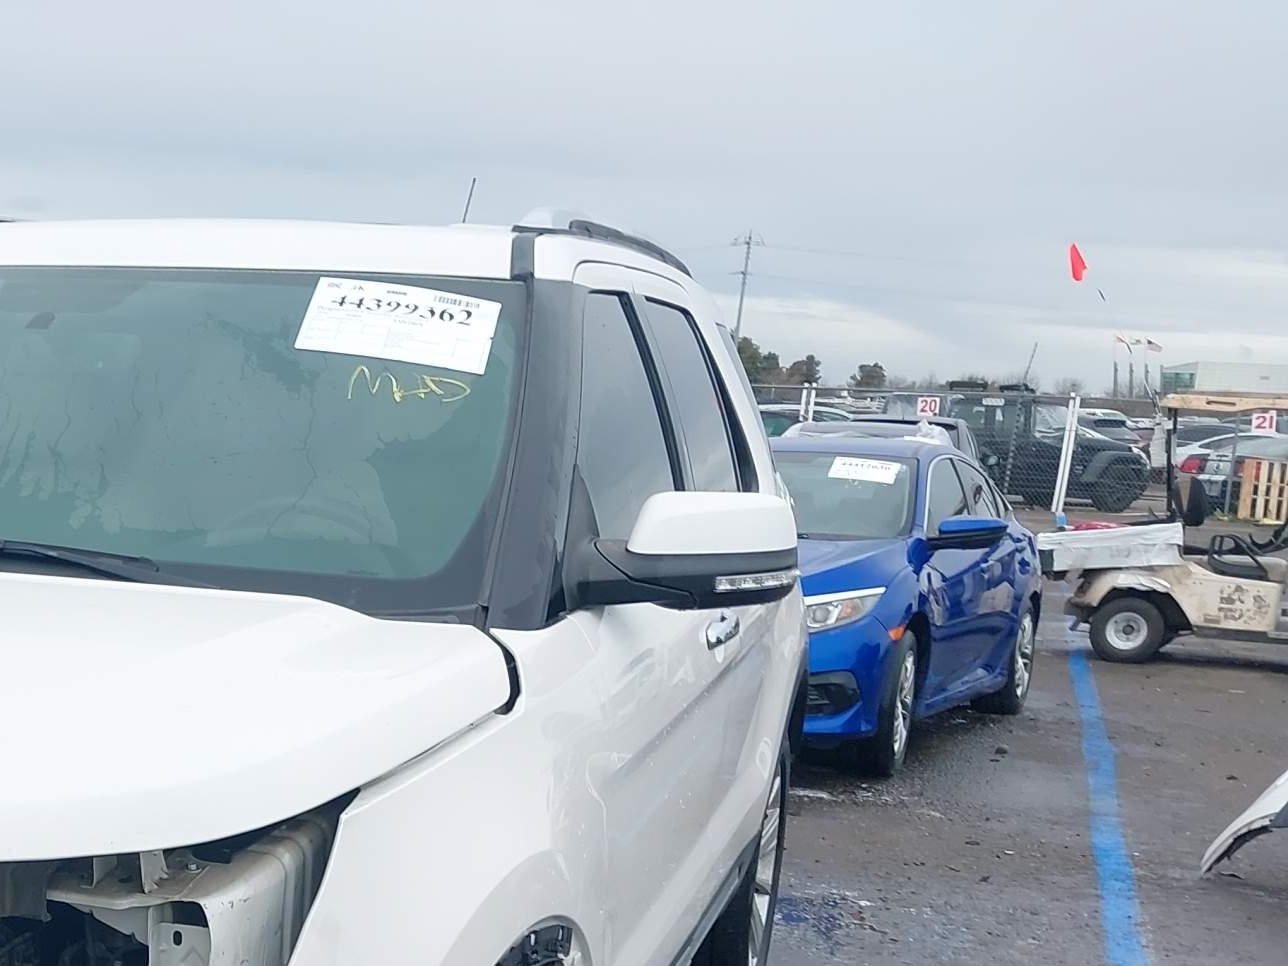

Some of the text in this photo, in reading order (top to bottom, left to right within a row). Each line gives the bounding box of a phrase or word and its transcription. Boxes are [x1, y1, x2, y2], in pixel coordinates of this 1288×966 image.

[331, 294, 473, 326] 44399362
[919, 399, 937, 413] 20
[1255, 415, 1274, 429] 21
